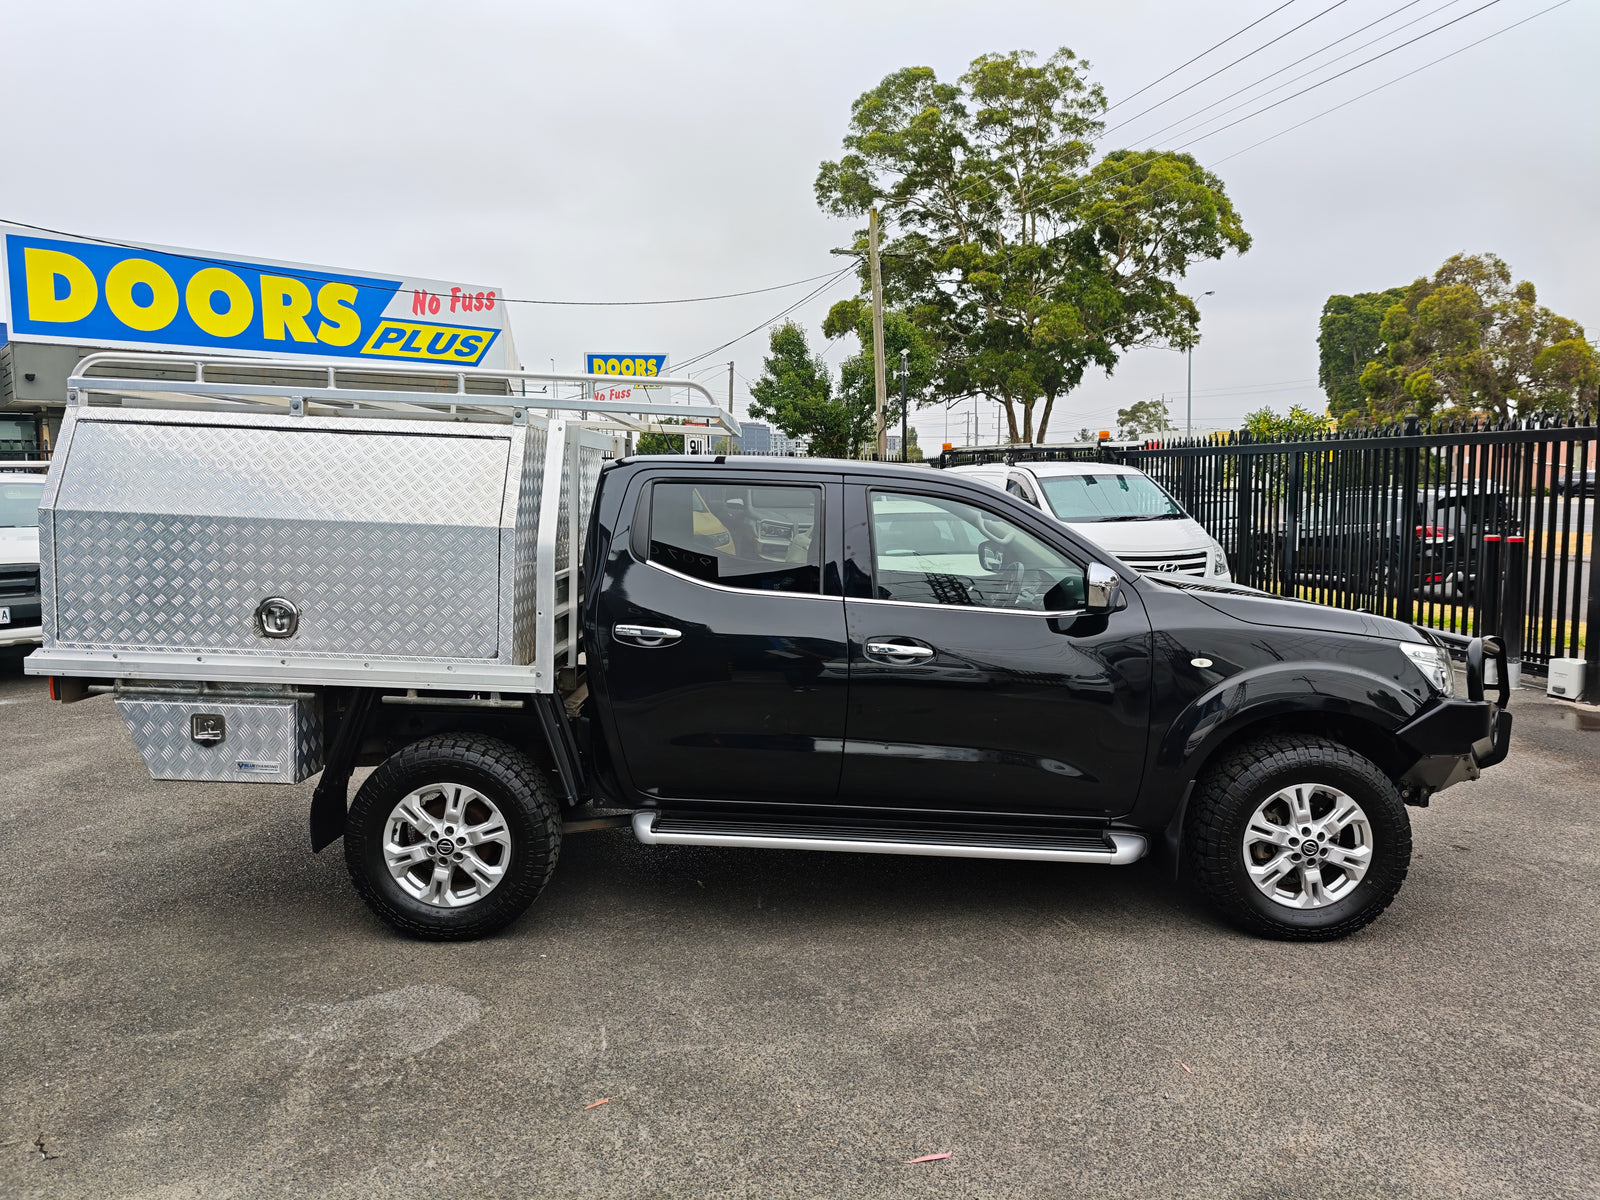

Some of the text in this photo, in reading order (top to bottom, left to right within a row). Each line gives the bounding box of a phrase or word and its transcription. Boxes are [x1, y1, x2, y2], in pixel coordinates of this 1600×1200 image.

[24, 247, 361, 346] DOORS
[412, 287, 496, 316] No Fuss
[371, 327, 483, 357] PLUS
[593, 358, 657, 377] DOORS
[609, 389, 631, 400] Fuss
